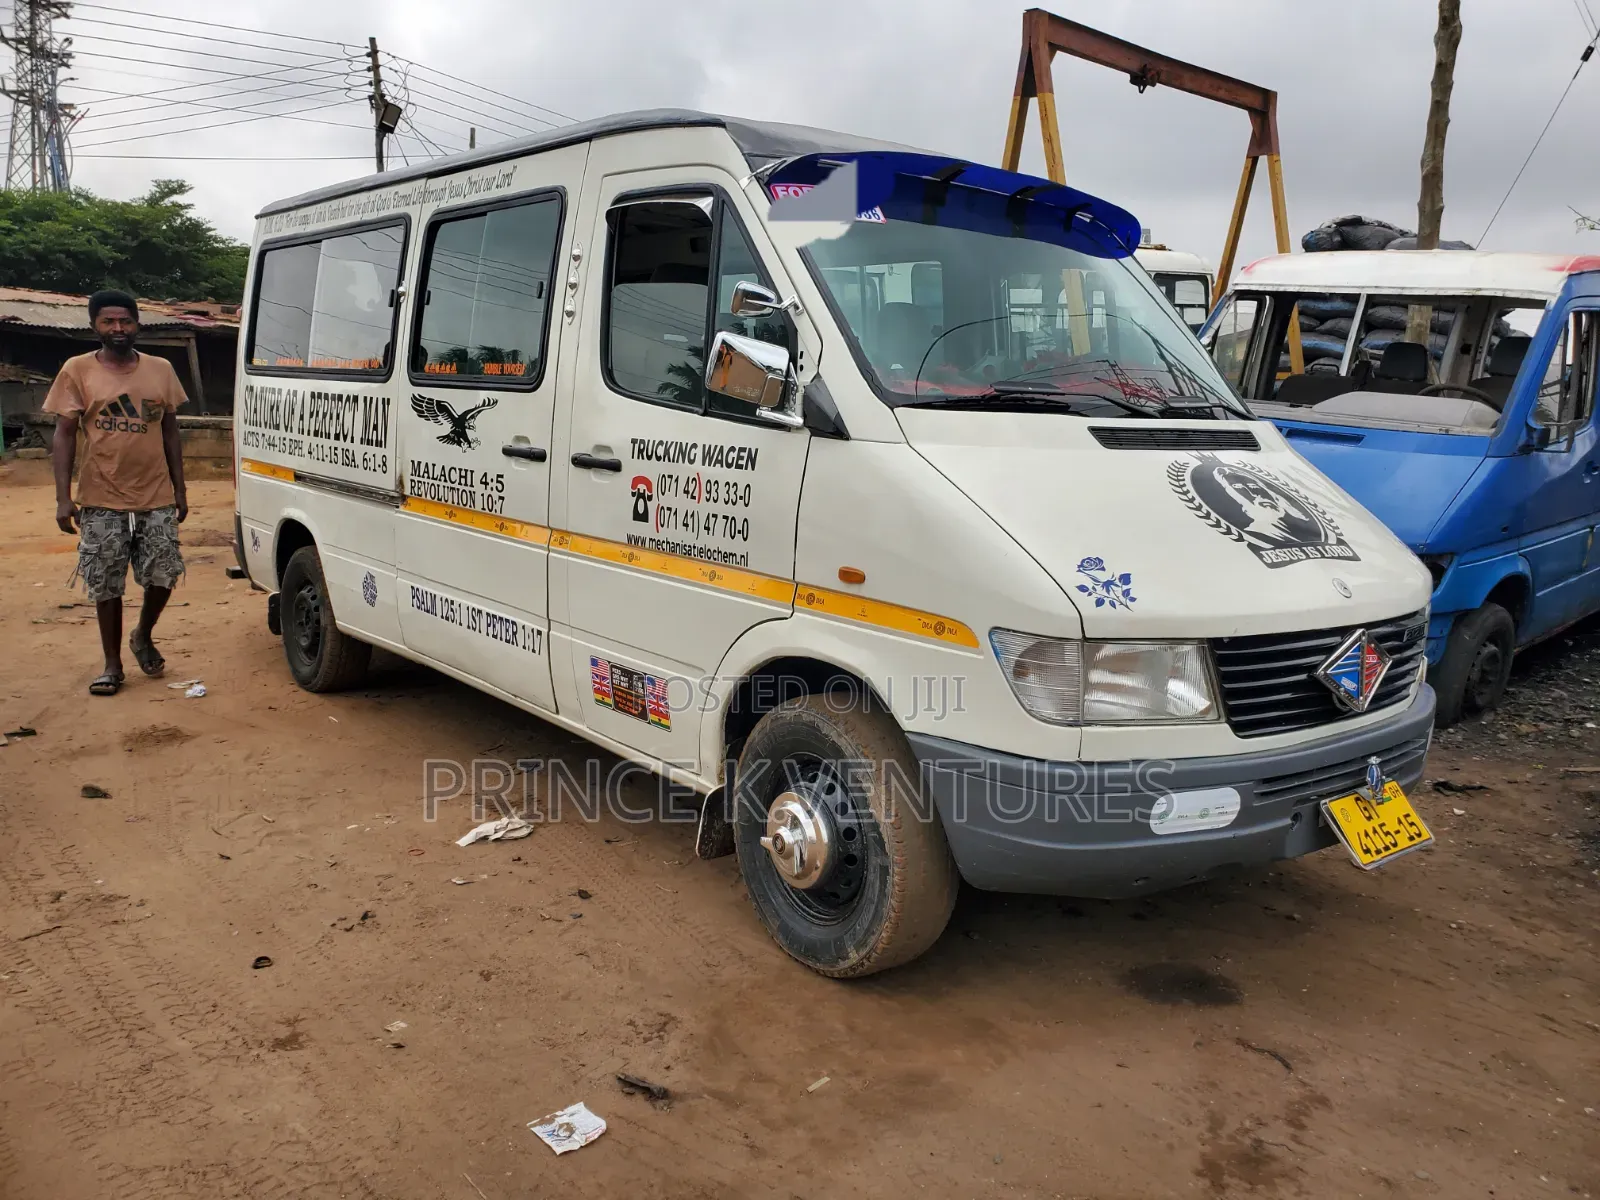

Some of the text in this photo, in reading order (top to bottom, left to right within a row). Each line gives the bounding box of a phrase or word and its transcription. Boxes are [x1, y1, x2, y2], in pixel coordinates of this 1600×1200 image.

[446, 180, 463, 204] Jesus
[463, 174, 484, 199] Christ
[482, 176, 496, 193] our
[95, 417, 148, 434] adidas
[243, 385, 391, 449] STATURE OF A PERFECT MAN
[243, 430, 260, 449] ACTS
[288, 438, 306, 459] EPH.
[308, 442, 339, 465] 4:11-15
[341, 448, 359, 469] ISA.
[362, 452, 388, 475] 6:1-8
[630, 438, 759, 472] TRUCKING WAGEN
[410, 459, 505, 493] MALACHI 4:5
[656, 472, 752, 508] (071 42) 93 33-0
[409, 479, 505, 515] REVOLUTION 10:7
[655, 503, 749, 542] (071 41) 47 70-0
[1260, 545, 1354, 564] JESUS IS LORD
[411, 585, 437, 617] PSALM
[440, 596, 463, 627] 125:1
[466, 605, 483, 634] 1ST
[486, 612, 519, 647] PETER
[522, 624, 543, 656] 1:17
[1388, 784, 1403, 799] GH
[1357, 812, 1423, 858] 4115-15
